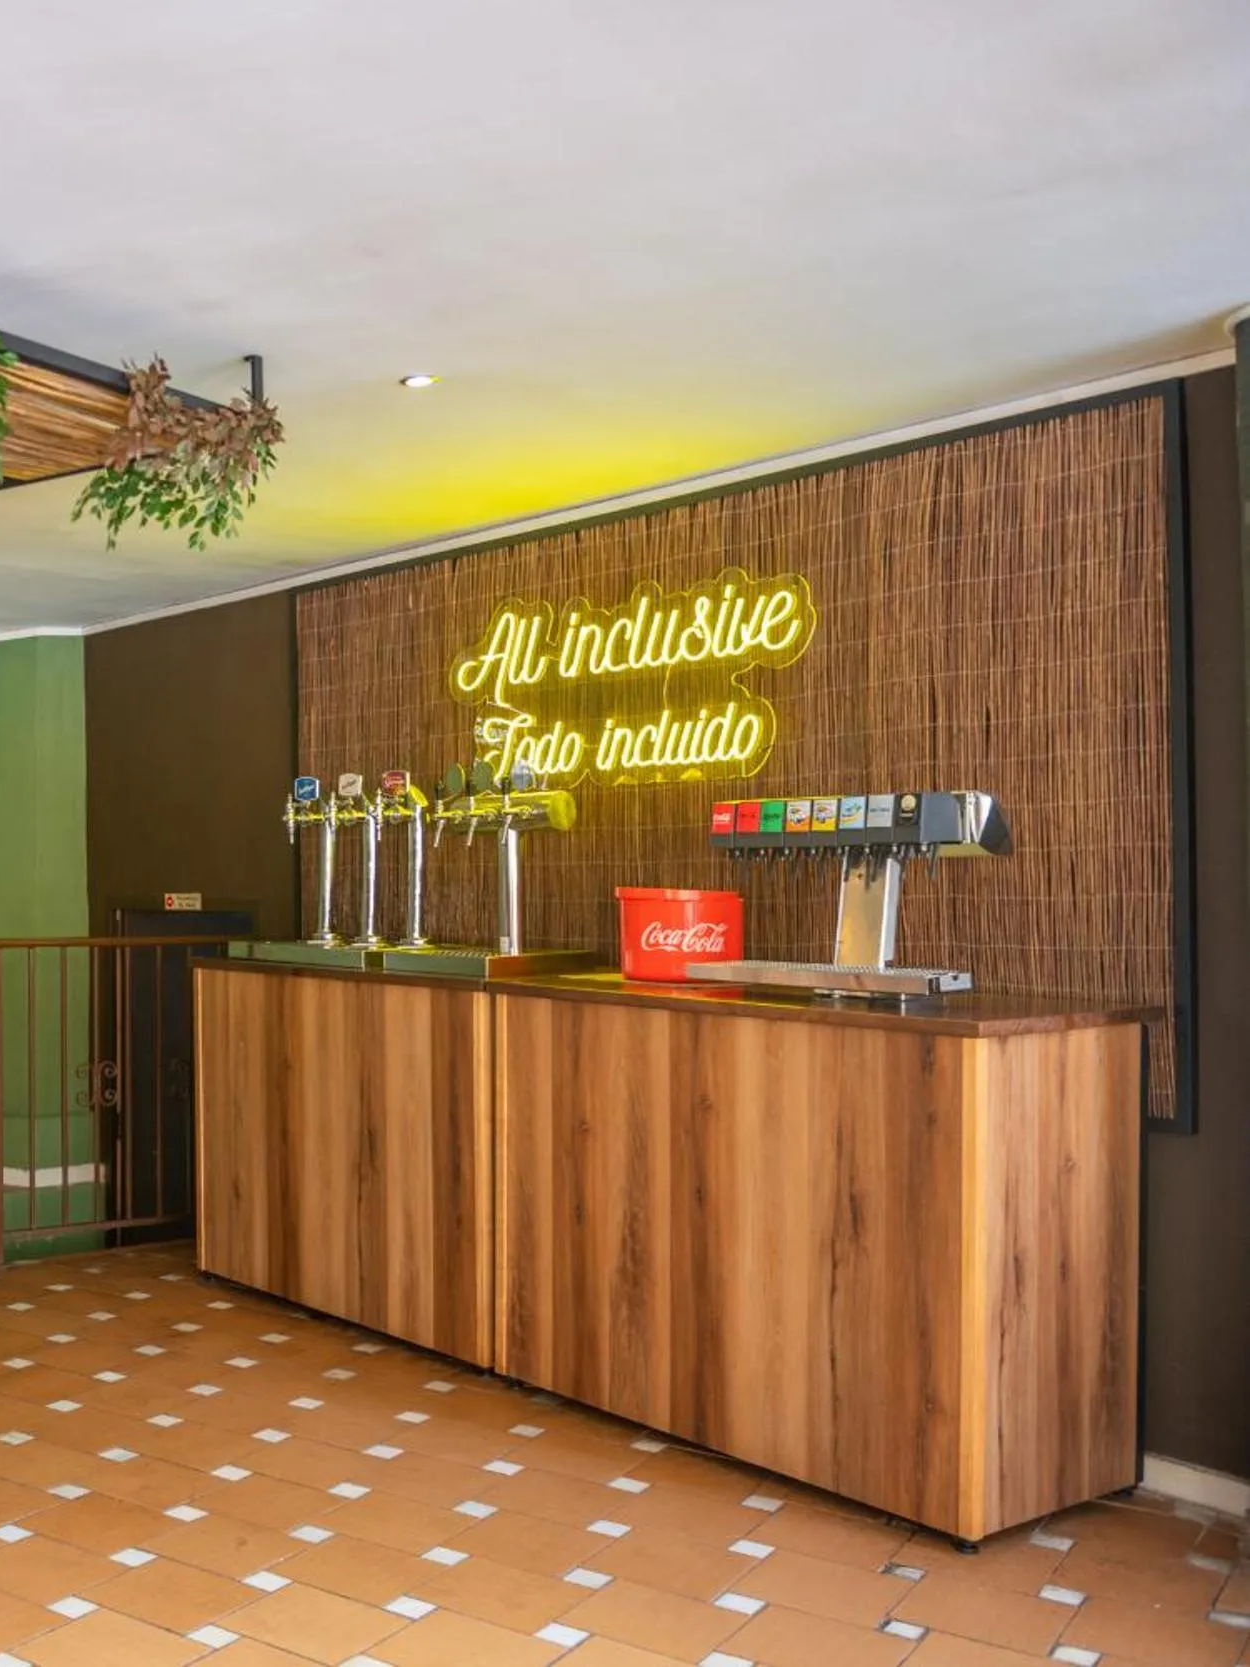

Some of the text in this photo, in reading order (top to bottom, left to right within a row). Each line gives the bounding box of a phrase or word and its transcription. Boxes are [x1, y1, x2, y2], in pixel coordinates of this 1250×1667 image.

[457, 583, 801, 708] All inclusive
[482, 701, 764, 787] Todo incluido
